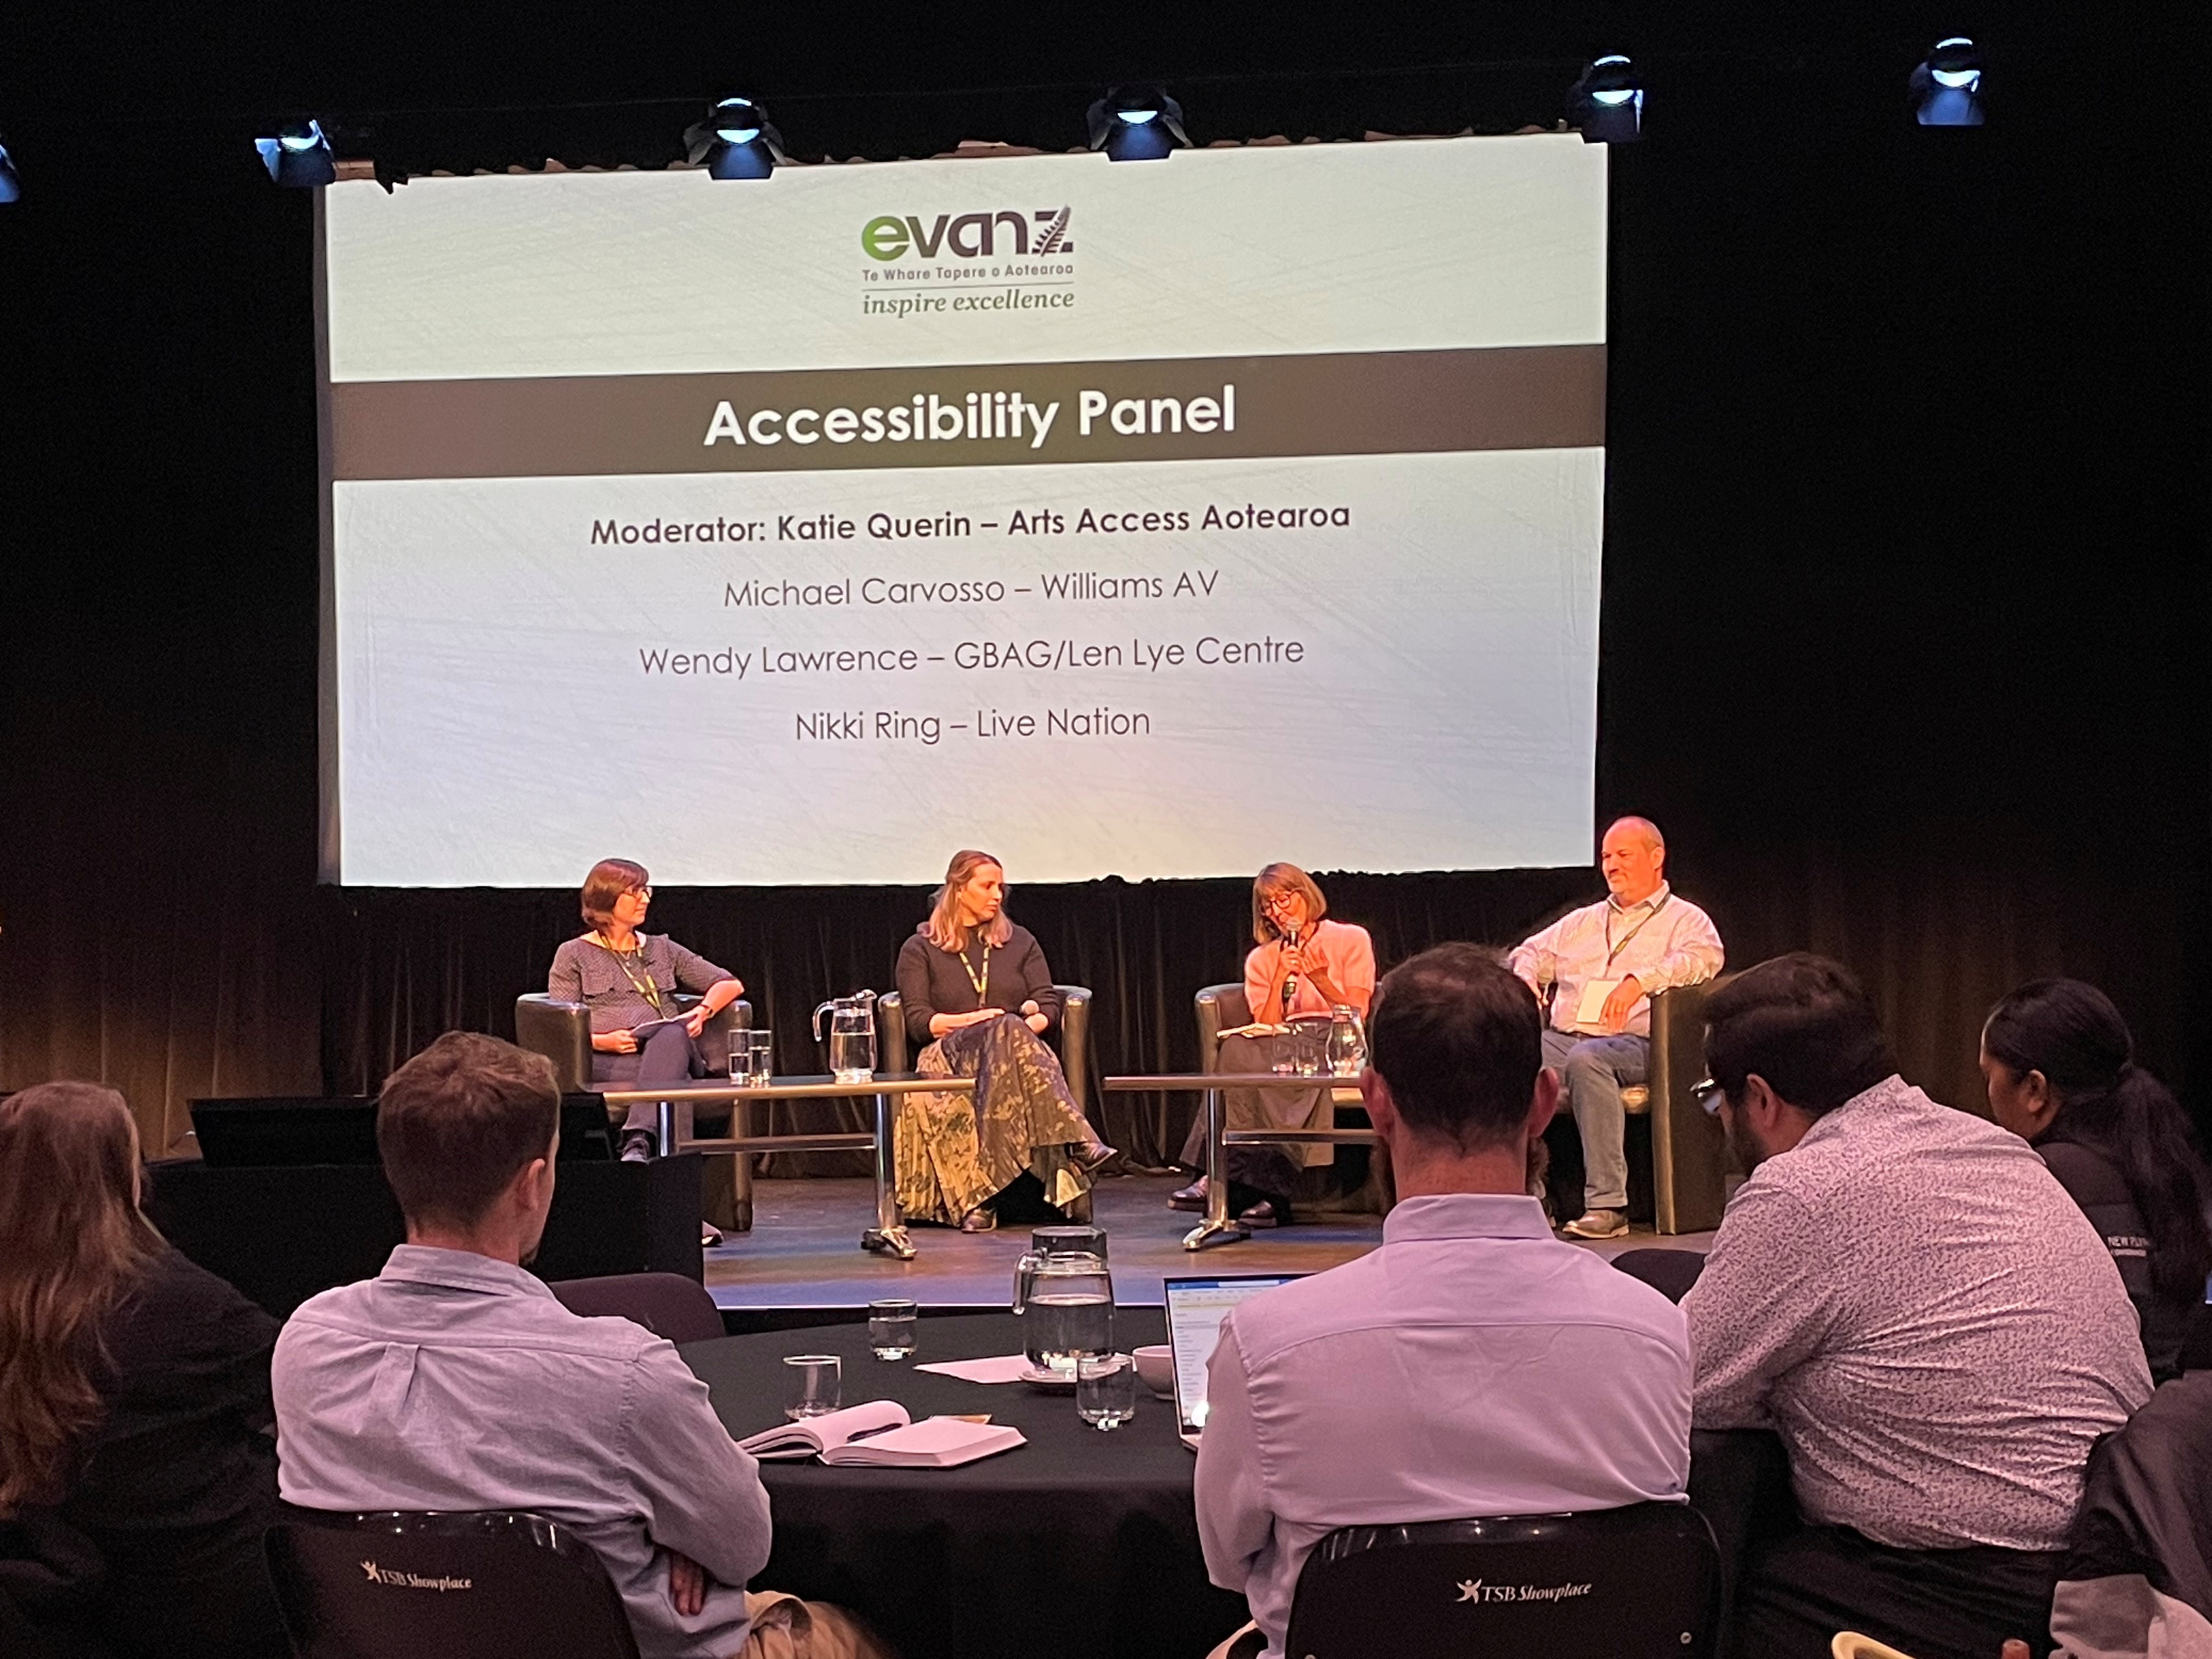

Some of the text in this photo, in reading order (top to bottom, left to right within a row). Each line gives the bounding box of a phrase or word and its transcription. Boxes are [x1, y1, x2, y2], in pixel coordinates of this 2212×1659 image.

[861, 204, 1074, 261] evanz
[862, 263, 1074, 281] Te Whare Tapere o Aotearoa
[863, 289, 1075, 318] inspire excellence
[703, 383, 1235, 449] Accessibility Panel
[590, 516, 766, 545] Moderator:
[777, 512, 856, 541] Katie
[867, 510, 971, 541] Querin
[1007, 508, 1065, 536] Arts
[1075, 507, 1190, 534] Access
[1200, 502, 1350, 531] Aotearoa
[724, 578, 851, 608] Michael
[861, 577, 1005, 605] Carvosso
[1040, 571, 1164, 600] Williams
[1172, 569, 1220, 598] AV
[639, 646, 753, 681] Wendy
[762, 646, 918, 673] Lawrence
[953, 639, 1122, 672] GBAG/Len
[1133, 637, 1186, 673] Lye
[1195, 635, 1305, 665] Centre
[796, 710, 864, 741] Nikki
[875, 710, 941, 746] Ring
[977, 708, 1036, 738] Live
[1047, 706, 1150, 737] Nation
[378, 1569, 472, 1593] TSB Showplace
[1481, 1582, 1592, 1602] TSB Showplace
